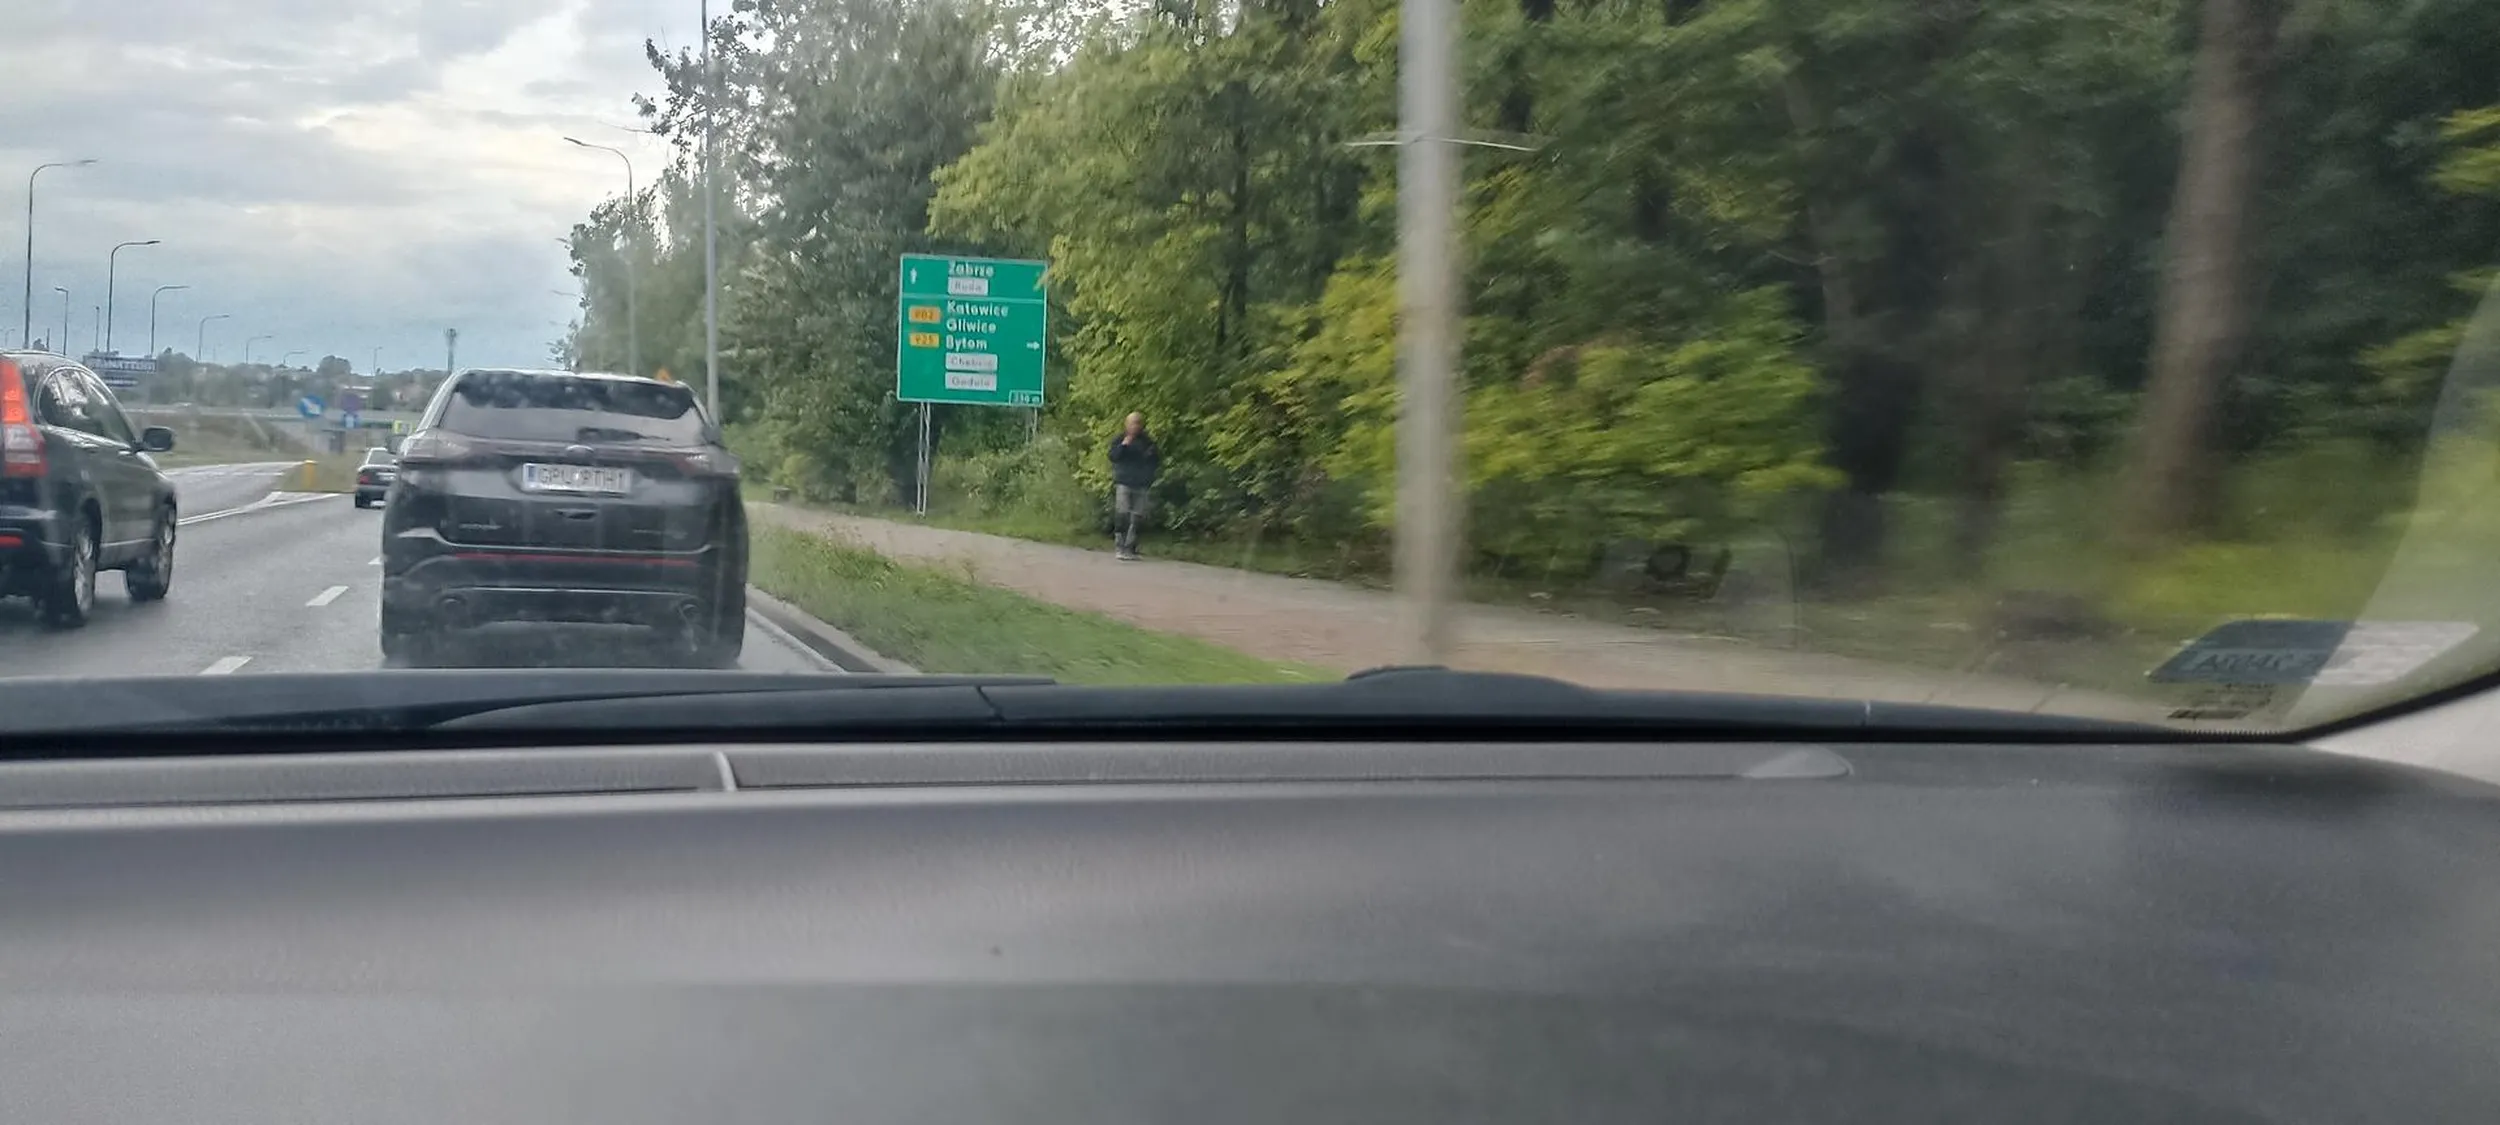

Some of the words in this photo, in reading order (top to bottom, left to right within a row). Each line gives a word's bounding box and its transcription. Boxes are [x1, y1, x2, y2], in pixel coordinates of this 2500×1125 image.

[948, 260, 995, 278] Zabrze
[947, 300, 1009, 317] Katowice
[946, 318, 997, 334] Gliwice
[945, 334, 988, 352] Bytom
